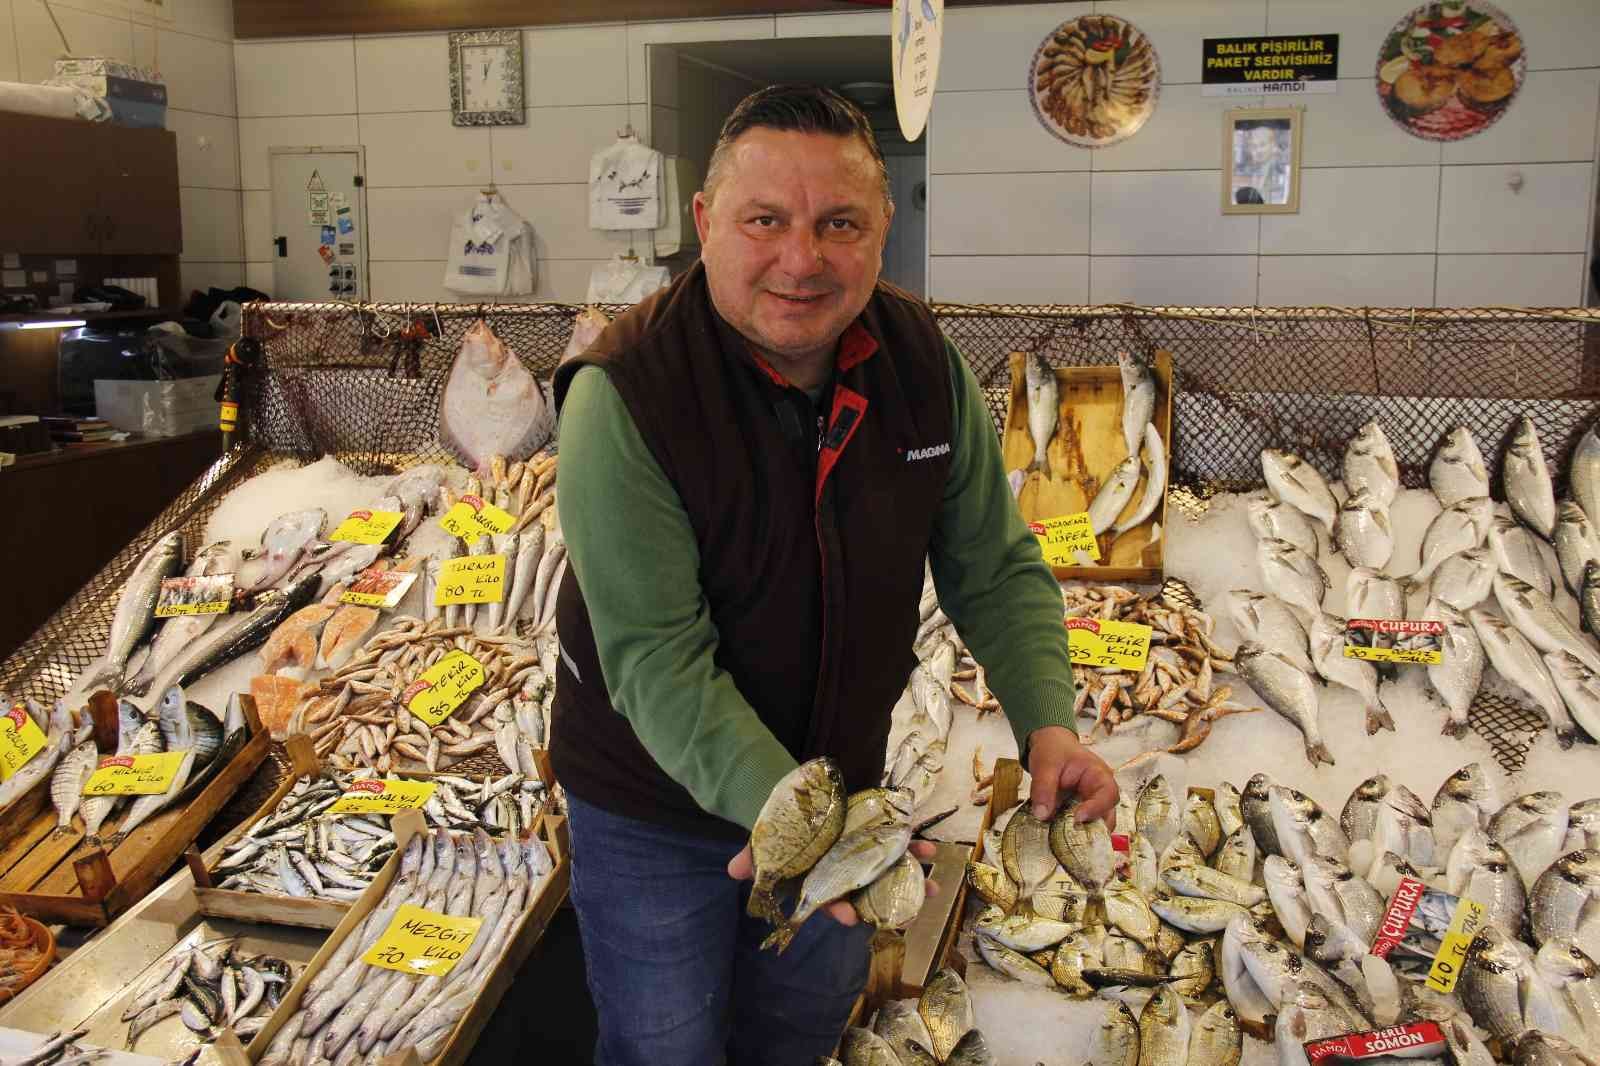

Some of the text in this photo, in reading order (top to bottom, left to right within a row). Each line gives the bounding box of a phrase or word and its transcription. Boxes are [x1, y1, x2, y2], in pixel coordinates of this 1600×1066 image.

[1216, 38, 1324, 55] BALIK PİŞİRİLİR
[1207, 53, 1333, 68] PAKET SERVİSİMİZ
[1243, 69, 1294, 80] VARDIR
[1100, 633, 1145, 647] TEKİR
[1097, 655, 1118, 664] TL
[1106, 646, 1142, 657] KİLO
[428, 661, 470, 693] TEKİR
[456, 668, 478, 688] KİLO
[400, 920, 472, 943] MEZGİT
[423, 945, 461, 960] KİLO
[1429, 961, 1454, 986] 40
[1453, 943, 1468, 956] TL
[1365, 1032, 1425, 1053] SOMON
